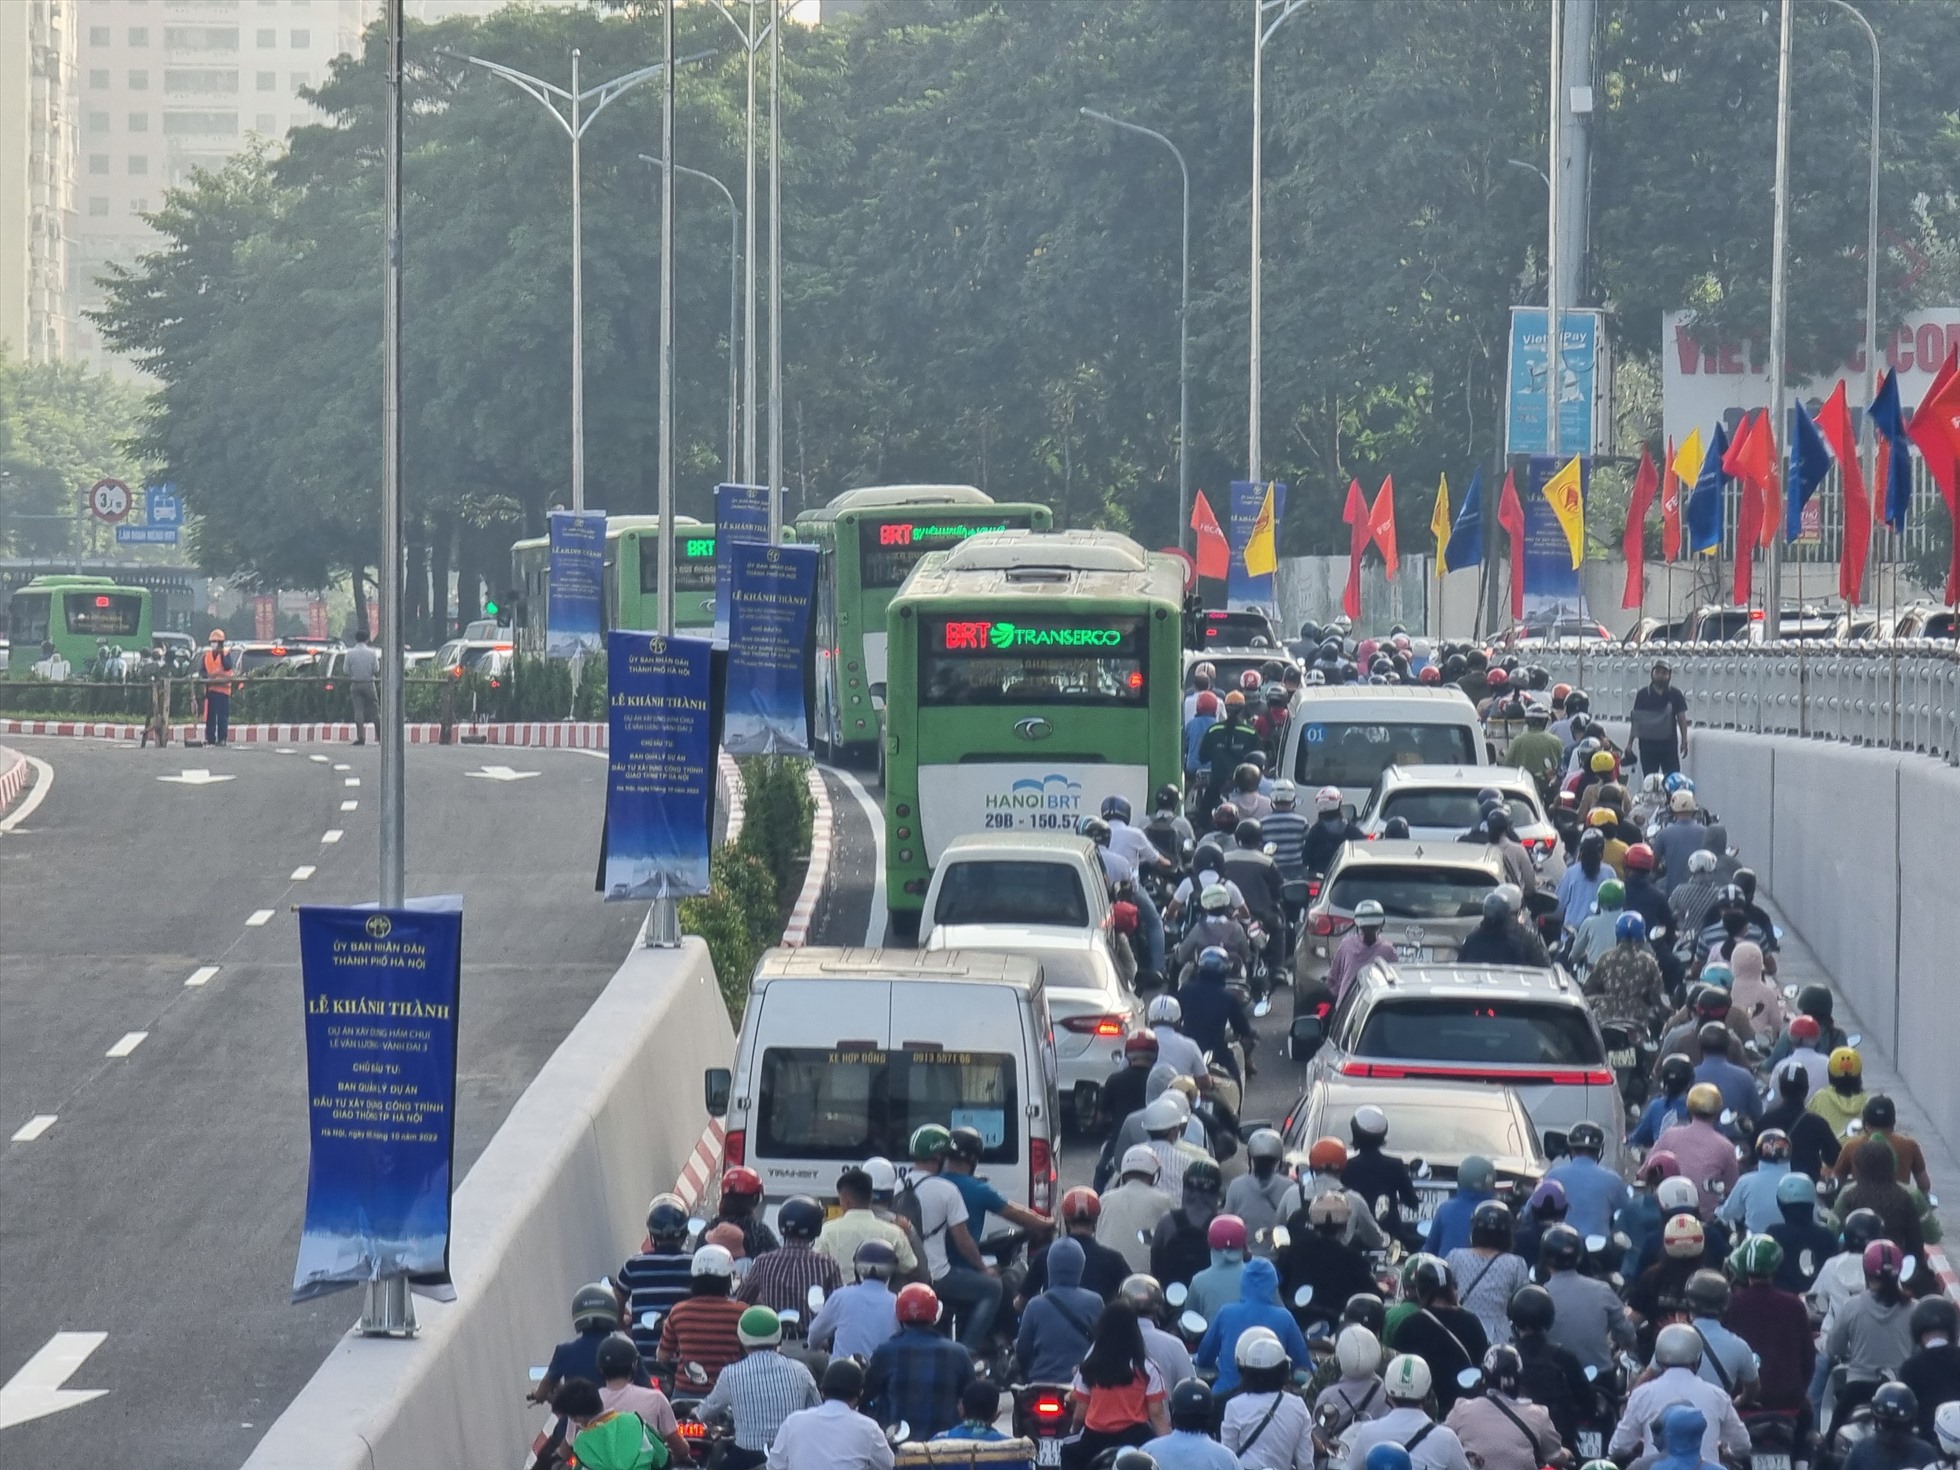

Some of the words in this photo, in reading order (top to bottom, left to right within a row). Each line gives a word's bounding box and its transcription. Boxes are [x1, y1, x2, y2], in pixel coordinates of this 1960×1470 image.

[880, 524, 913, 545] BRT
[687, 539, 716, 557] BRT
[946, 622, 991, 648] BRT
[1014, 629, 1121, 646] TRANSERCO
[611, 692, 626, 706] LỄ
[628, 694, 664, 708] KHÁNH
[666, 695, 707, 711] THÀNH
[1307, 727, 1323, 742] 01
[985, 794, 1044, 809] HANOI
[985, 813, 1013, 829] 29B
[1030, 813, 1080, 830] 150.57
[351, 942, 371, 952] BAN
[374, 942, 400, 953] NHÂN
[403, 943, 426, 955] DÂN
[333, 955, 368, 966] THÀNH
[371, 954, 388, 967] PHỐ
[391, 957, 405, 968] HÀ
[407, 958, 426, 970] NỘI
[309, 994, 330, 1014] LỄ
[333, 996, 386, 1016] KHÁNH
[388, 998, 450, 1020] THÀNH
[338, 1081, 356, 1092] BAN
[390, 1084, 403, 1096] DỰ
[405, 1083, 418, 1095] ÁN
[313, 1095, 333, 1107] ĐẦU
[335, 1097, 348, 1108] TƯ
[348, 1097, 365, 1109] XÂY
[385, 1100, 411, 1112] CÔNG
[414, 1101, 444, 1113] TRÌNH
[332, 1109, 354, 1119] GIAO
[392, 1112, 404, 1123] HÀ
[406, 1112, 423, 1124] NỘI
